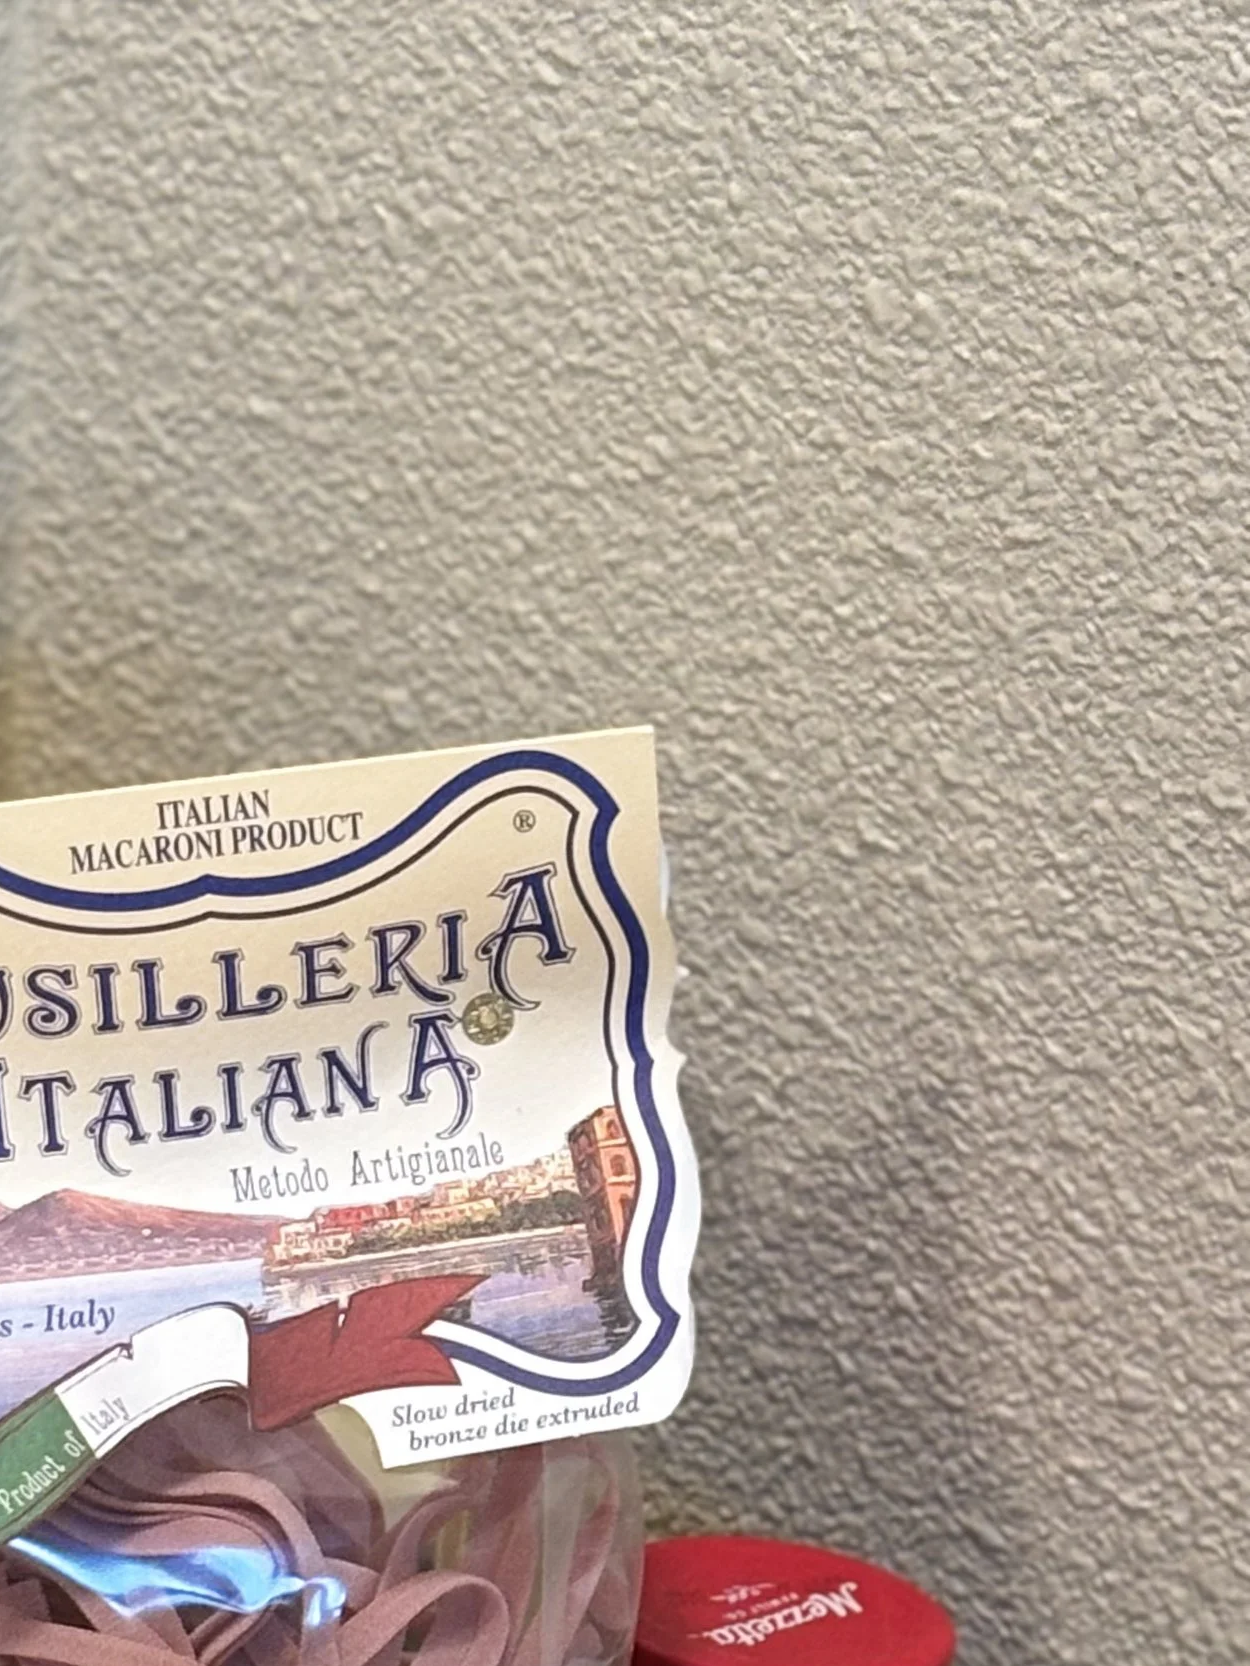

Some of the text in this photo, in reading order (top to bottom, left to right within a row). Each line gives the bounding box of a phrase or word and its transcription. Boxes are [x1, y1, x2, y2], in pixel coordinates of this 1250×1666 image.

[155, 790, 272, 831] ITALIAN
[70, 811, 364, 875] MACARONI PRODUCT
[230, 1133, 504, 1203] Metodo Artigianale
[44, 1299, 116, 1335] Italy
[64, 1428, 87, 1458] of
[81, 1394, 128, 1436] Italy
[391, 1387, 515, 1428] Slow dried
[409, 1392, 641, 1452] bronze die extruded
[703, 1582, 863, 1647] Mezzetta
